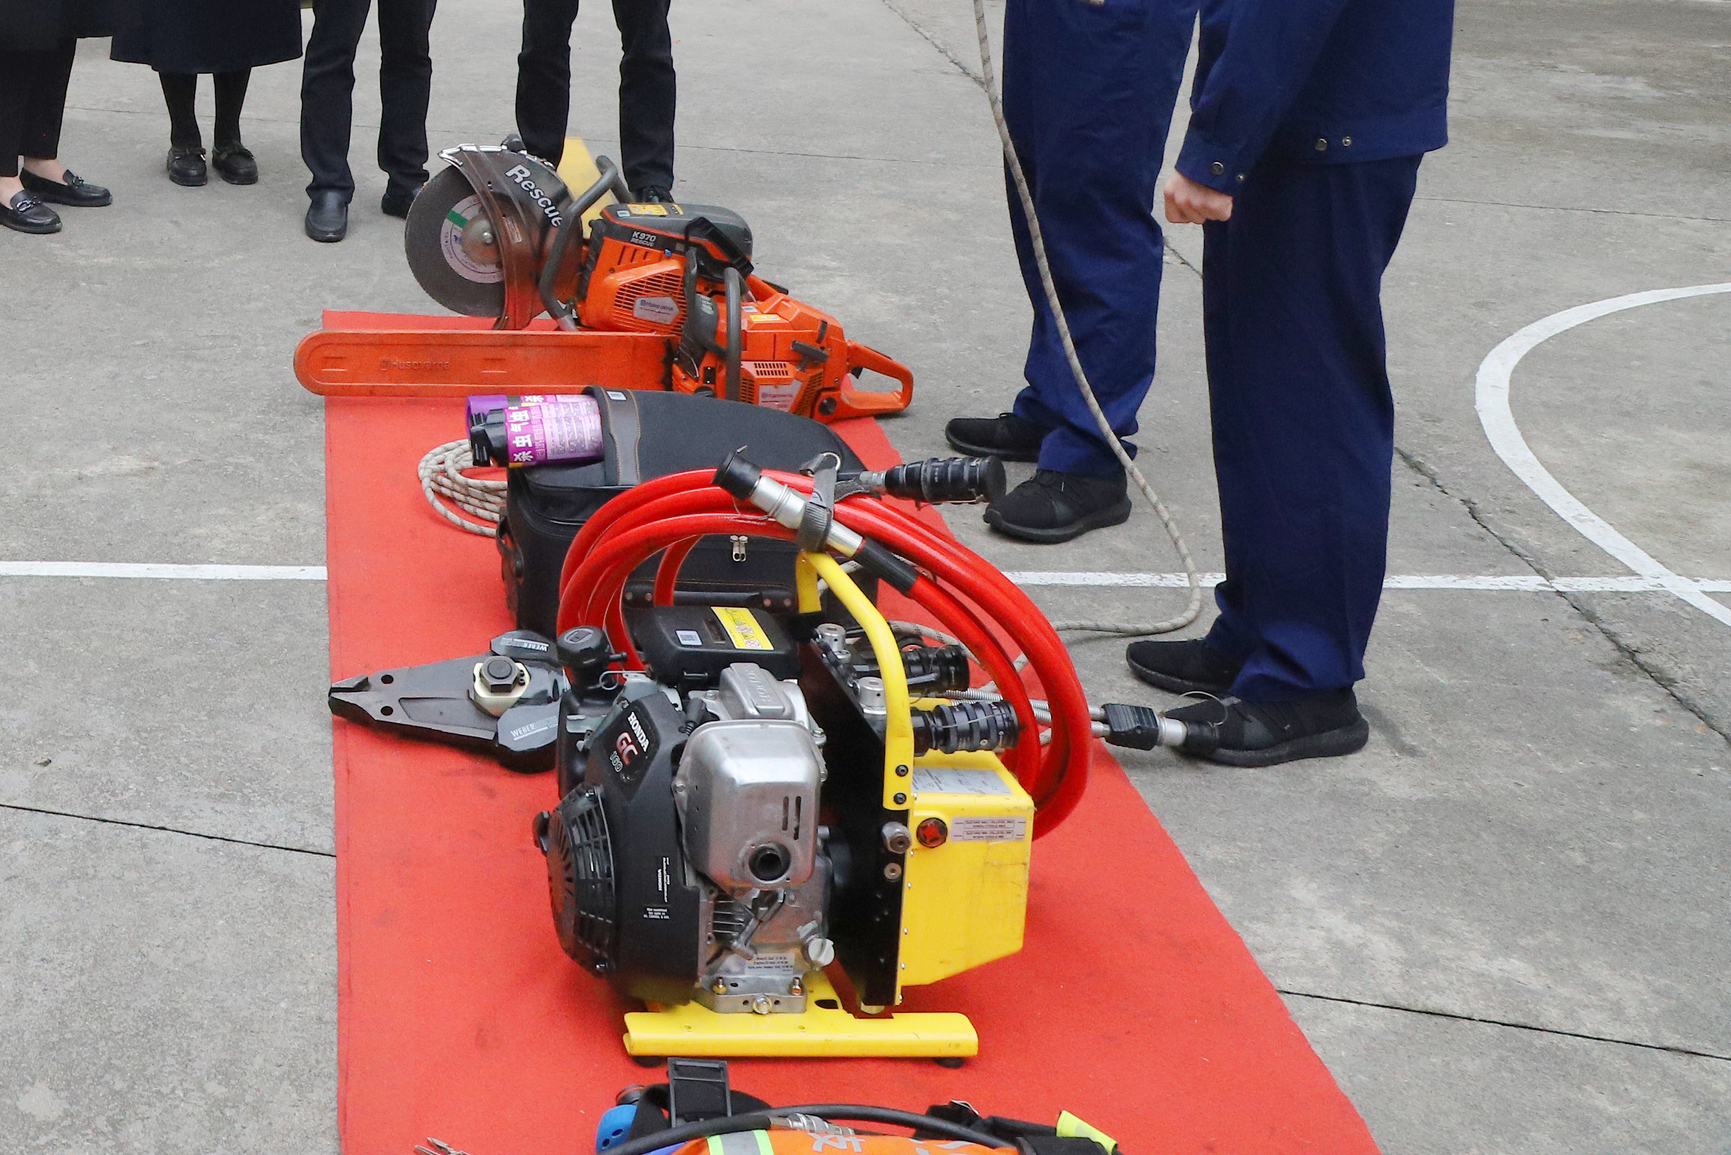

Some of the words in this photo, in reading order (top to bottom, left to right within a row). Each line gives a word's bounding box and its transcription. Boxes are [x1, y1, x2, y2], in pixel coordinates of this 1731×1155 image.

[505, 164, 563, 228] Rescue
[510, 722, 536, 738] WEBER
[628, 712, 650, 753] HONDA
[616, 732, 638, 766] GC
